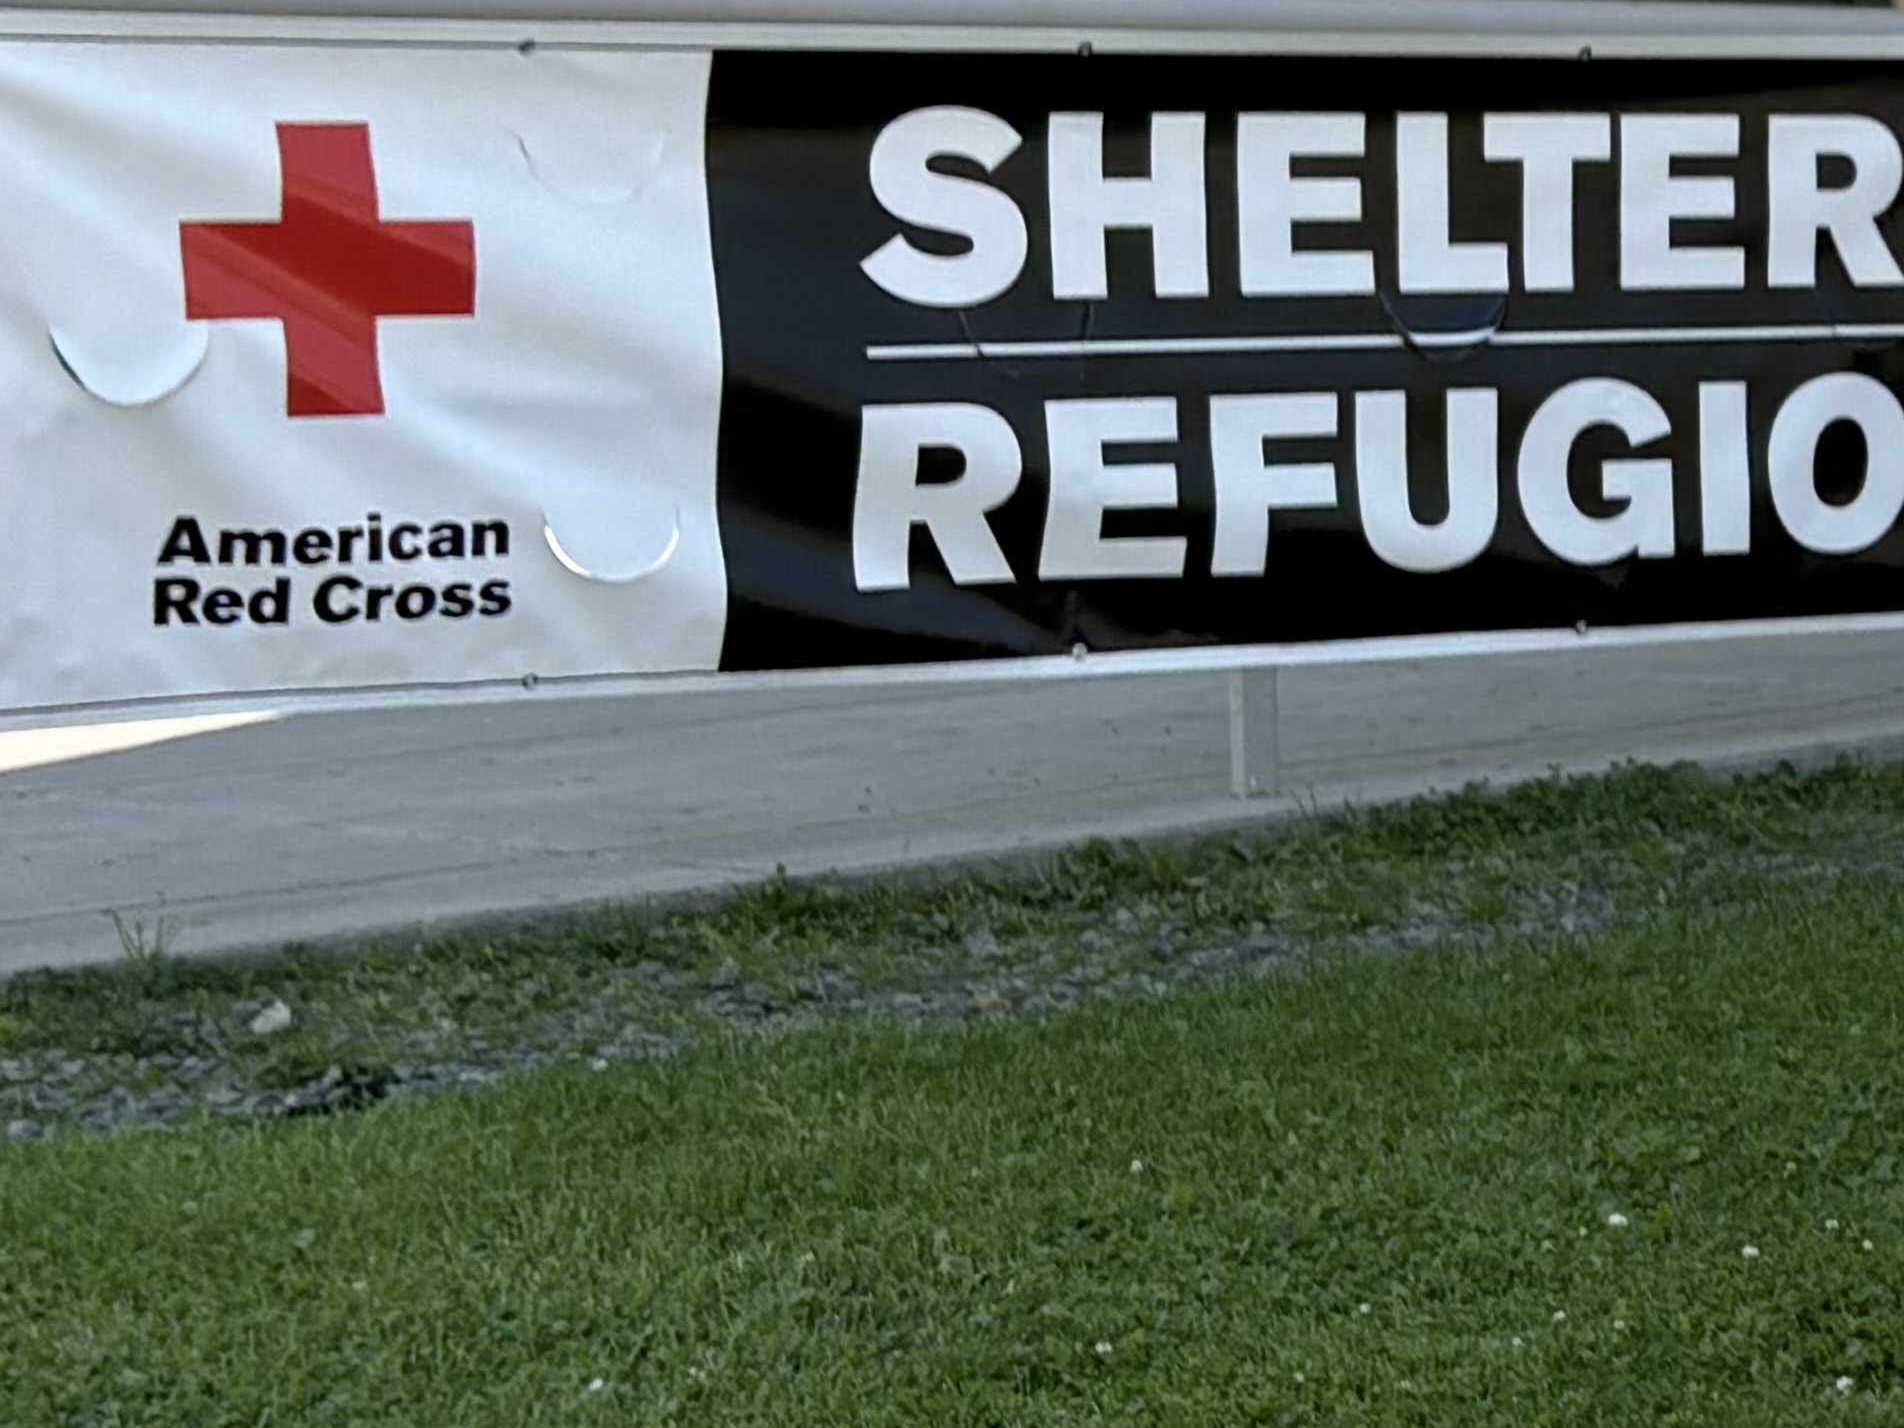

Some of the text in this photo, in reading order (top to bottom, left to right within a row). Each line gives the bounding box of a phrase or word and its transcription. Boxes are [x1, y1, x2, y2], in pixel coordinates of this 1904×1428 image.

[154, 512, 512, 568] American
[152, 572, 512, 628] Red Cross
